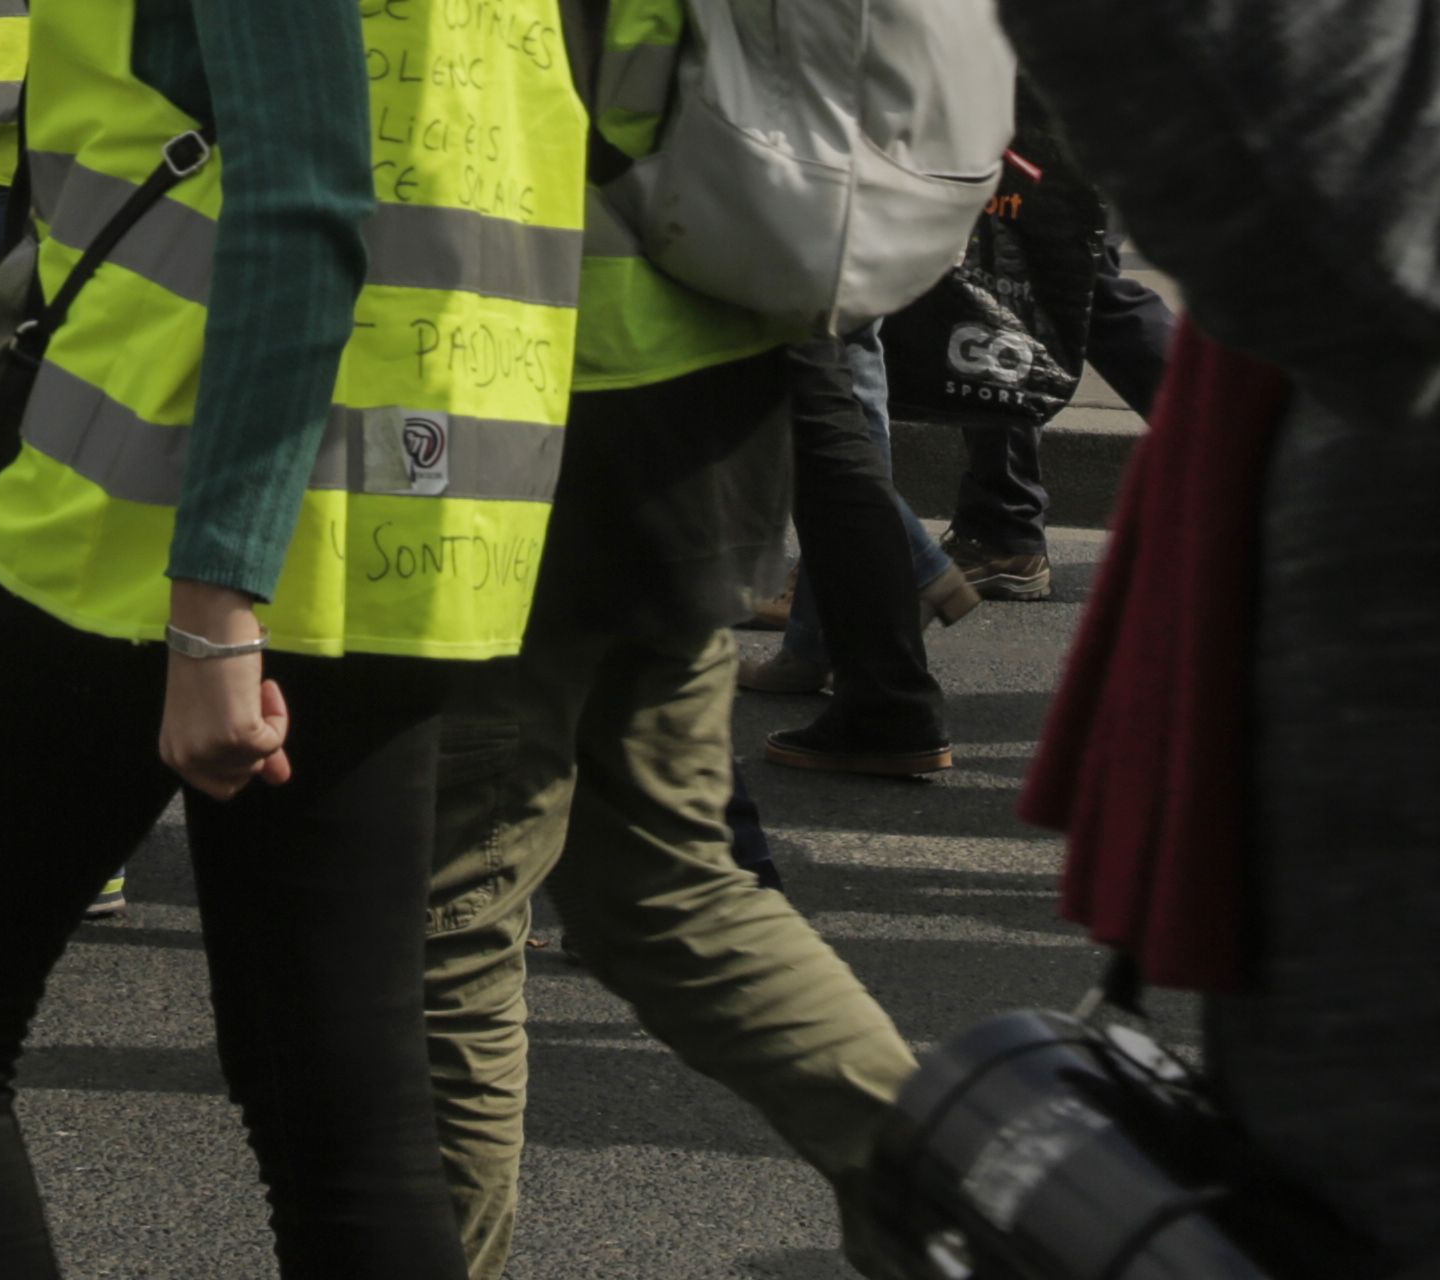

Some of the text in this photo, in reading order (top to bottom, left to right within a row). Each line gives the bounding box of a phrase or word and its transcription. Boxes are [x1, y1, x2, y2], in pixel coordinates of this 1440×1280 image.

[947, 325, 1034, 383] GO
[946, 381, 1025, 405] SPORT
[366, 522, 472, 583] SONT
